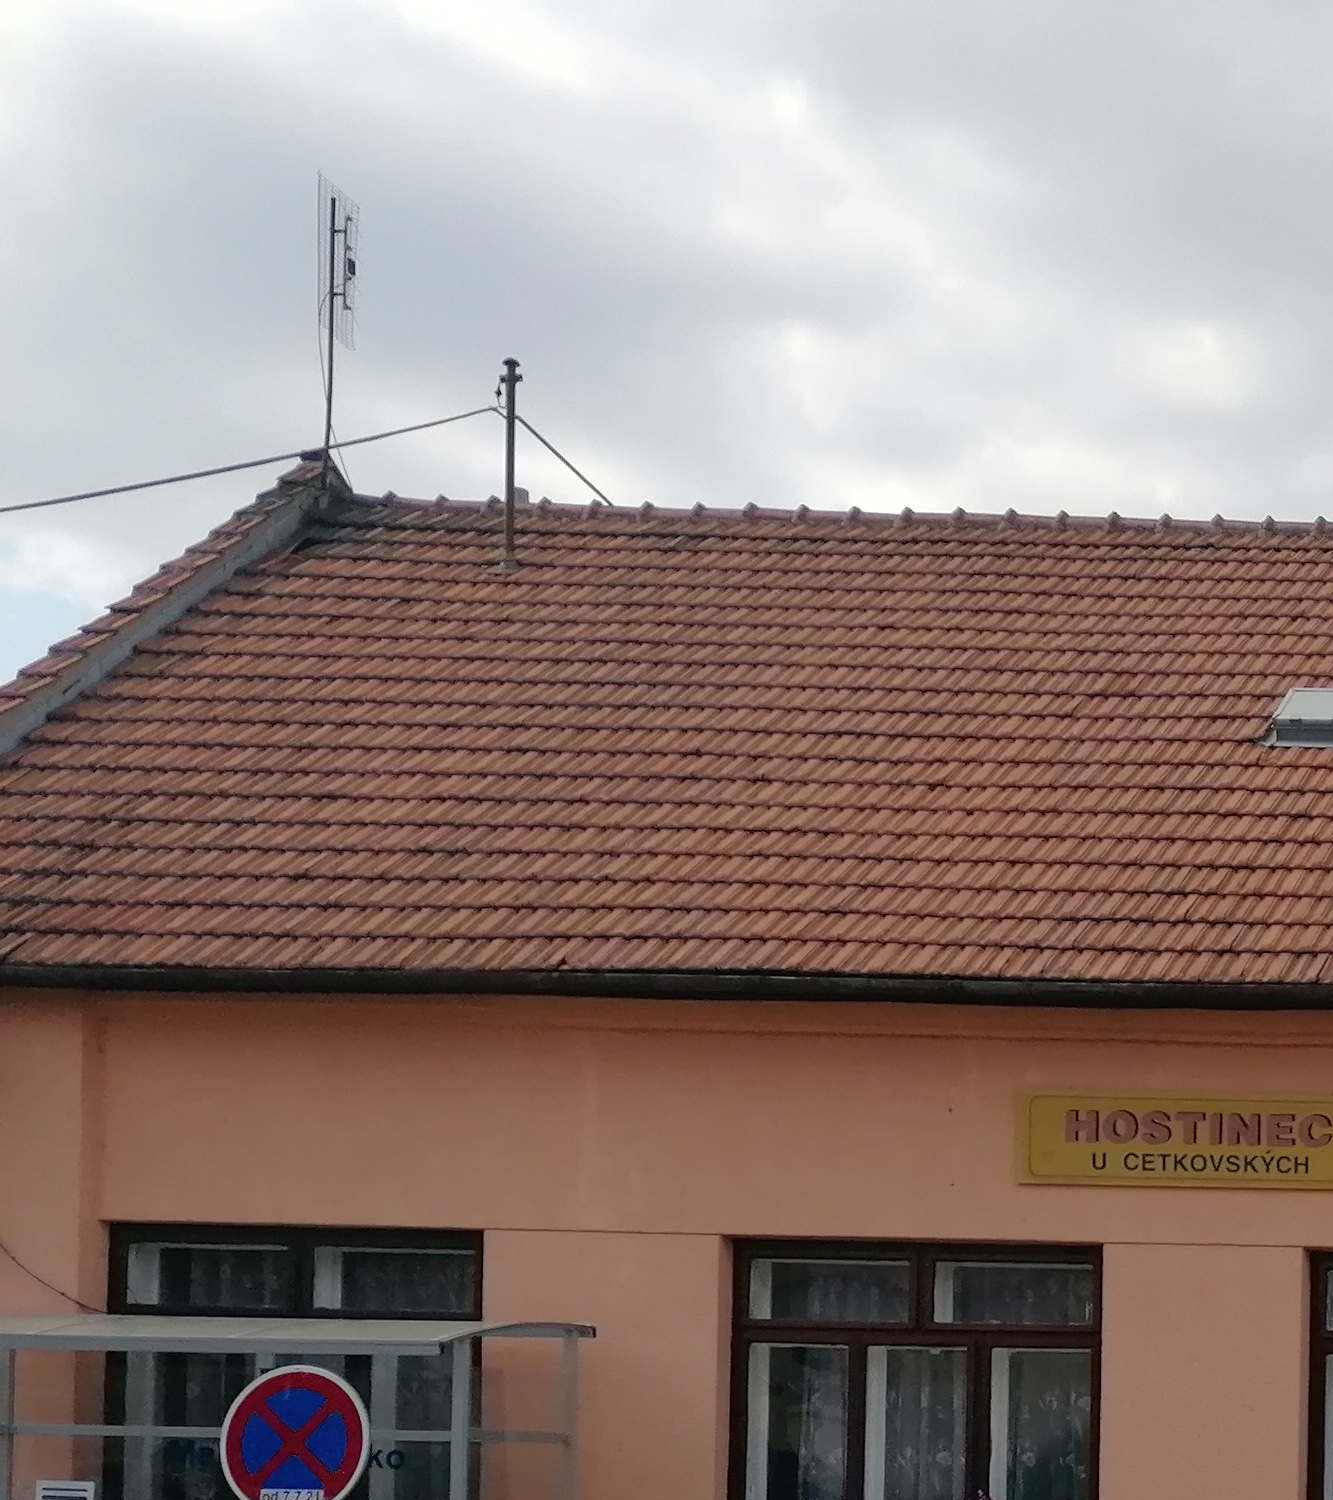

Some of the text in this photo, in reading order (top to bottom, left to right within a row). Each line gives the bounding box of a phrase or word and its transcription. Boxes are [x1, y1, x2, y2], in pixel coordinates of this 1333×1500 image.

[1064, 1109, 1333, 1148] HOSTINEC
[1092, 1150, 1309, 1173] U CETKOVSKÝCH
